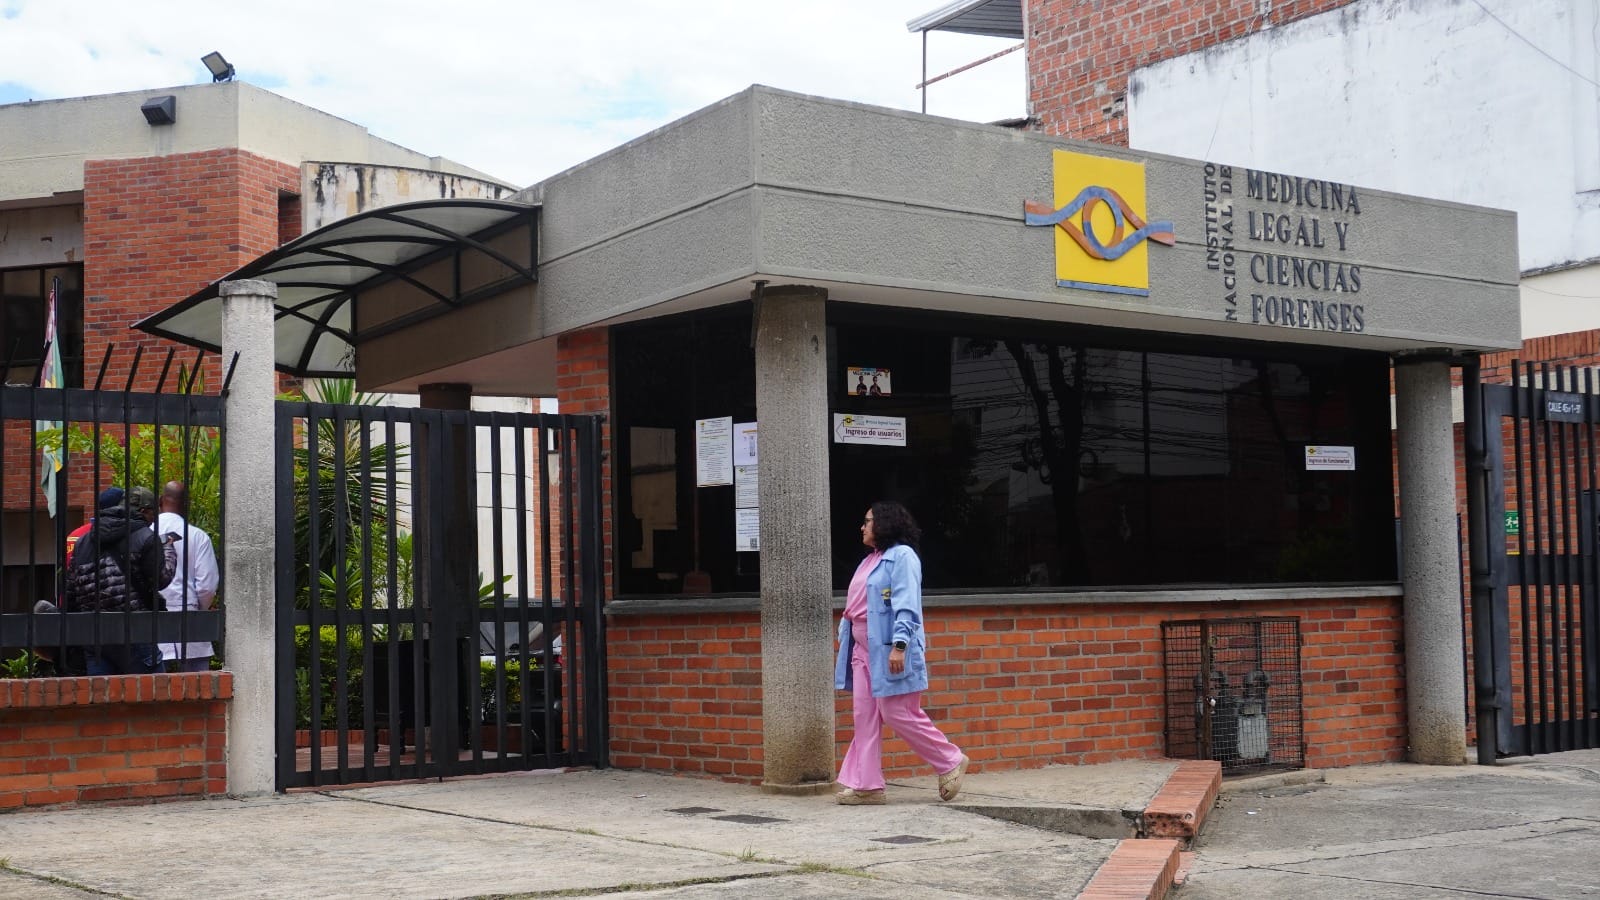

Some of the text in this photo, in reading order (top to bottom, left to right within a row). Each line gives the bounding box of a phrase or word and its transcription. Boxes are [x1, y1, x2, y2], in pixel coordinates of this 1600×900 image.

[1246, 168, 1361, 214] MEDICINA
[1204, 162, 1219, 270] INSTITUTO
[1248, 211, 1349, 251] LEGAL Y
[1220, 165, 1238, 321] NACIONAL DE
[1250, 253, 1361, 293] CIENCIAS
[1250, 293, 1365, 333] FORENSES
[845, 427, 902, 438] Ingreso de usuarios
